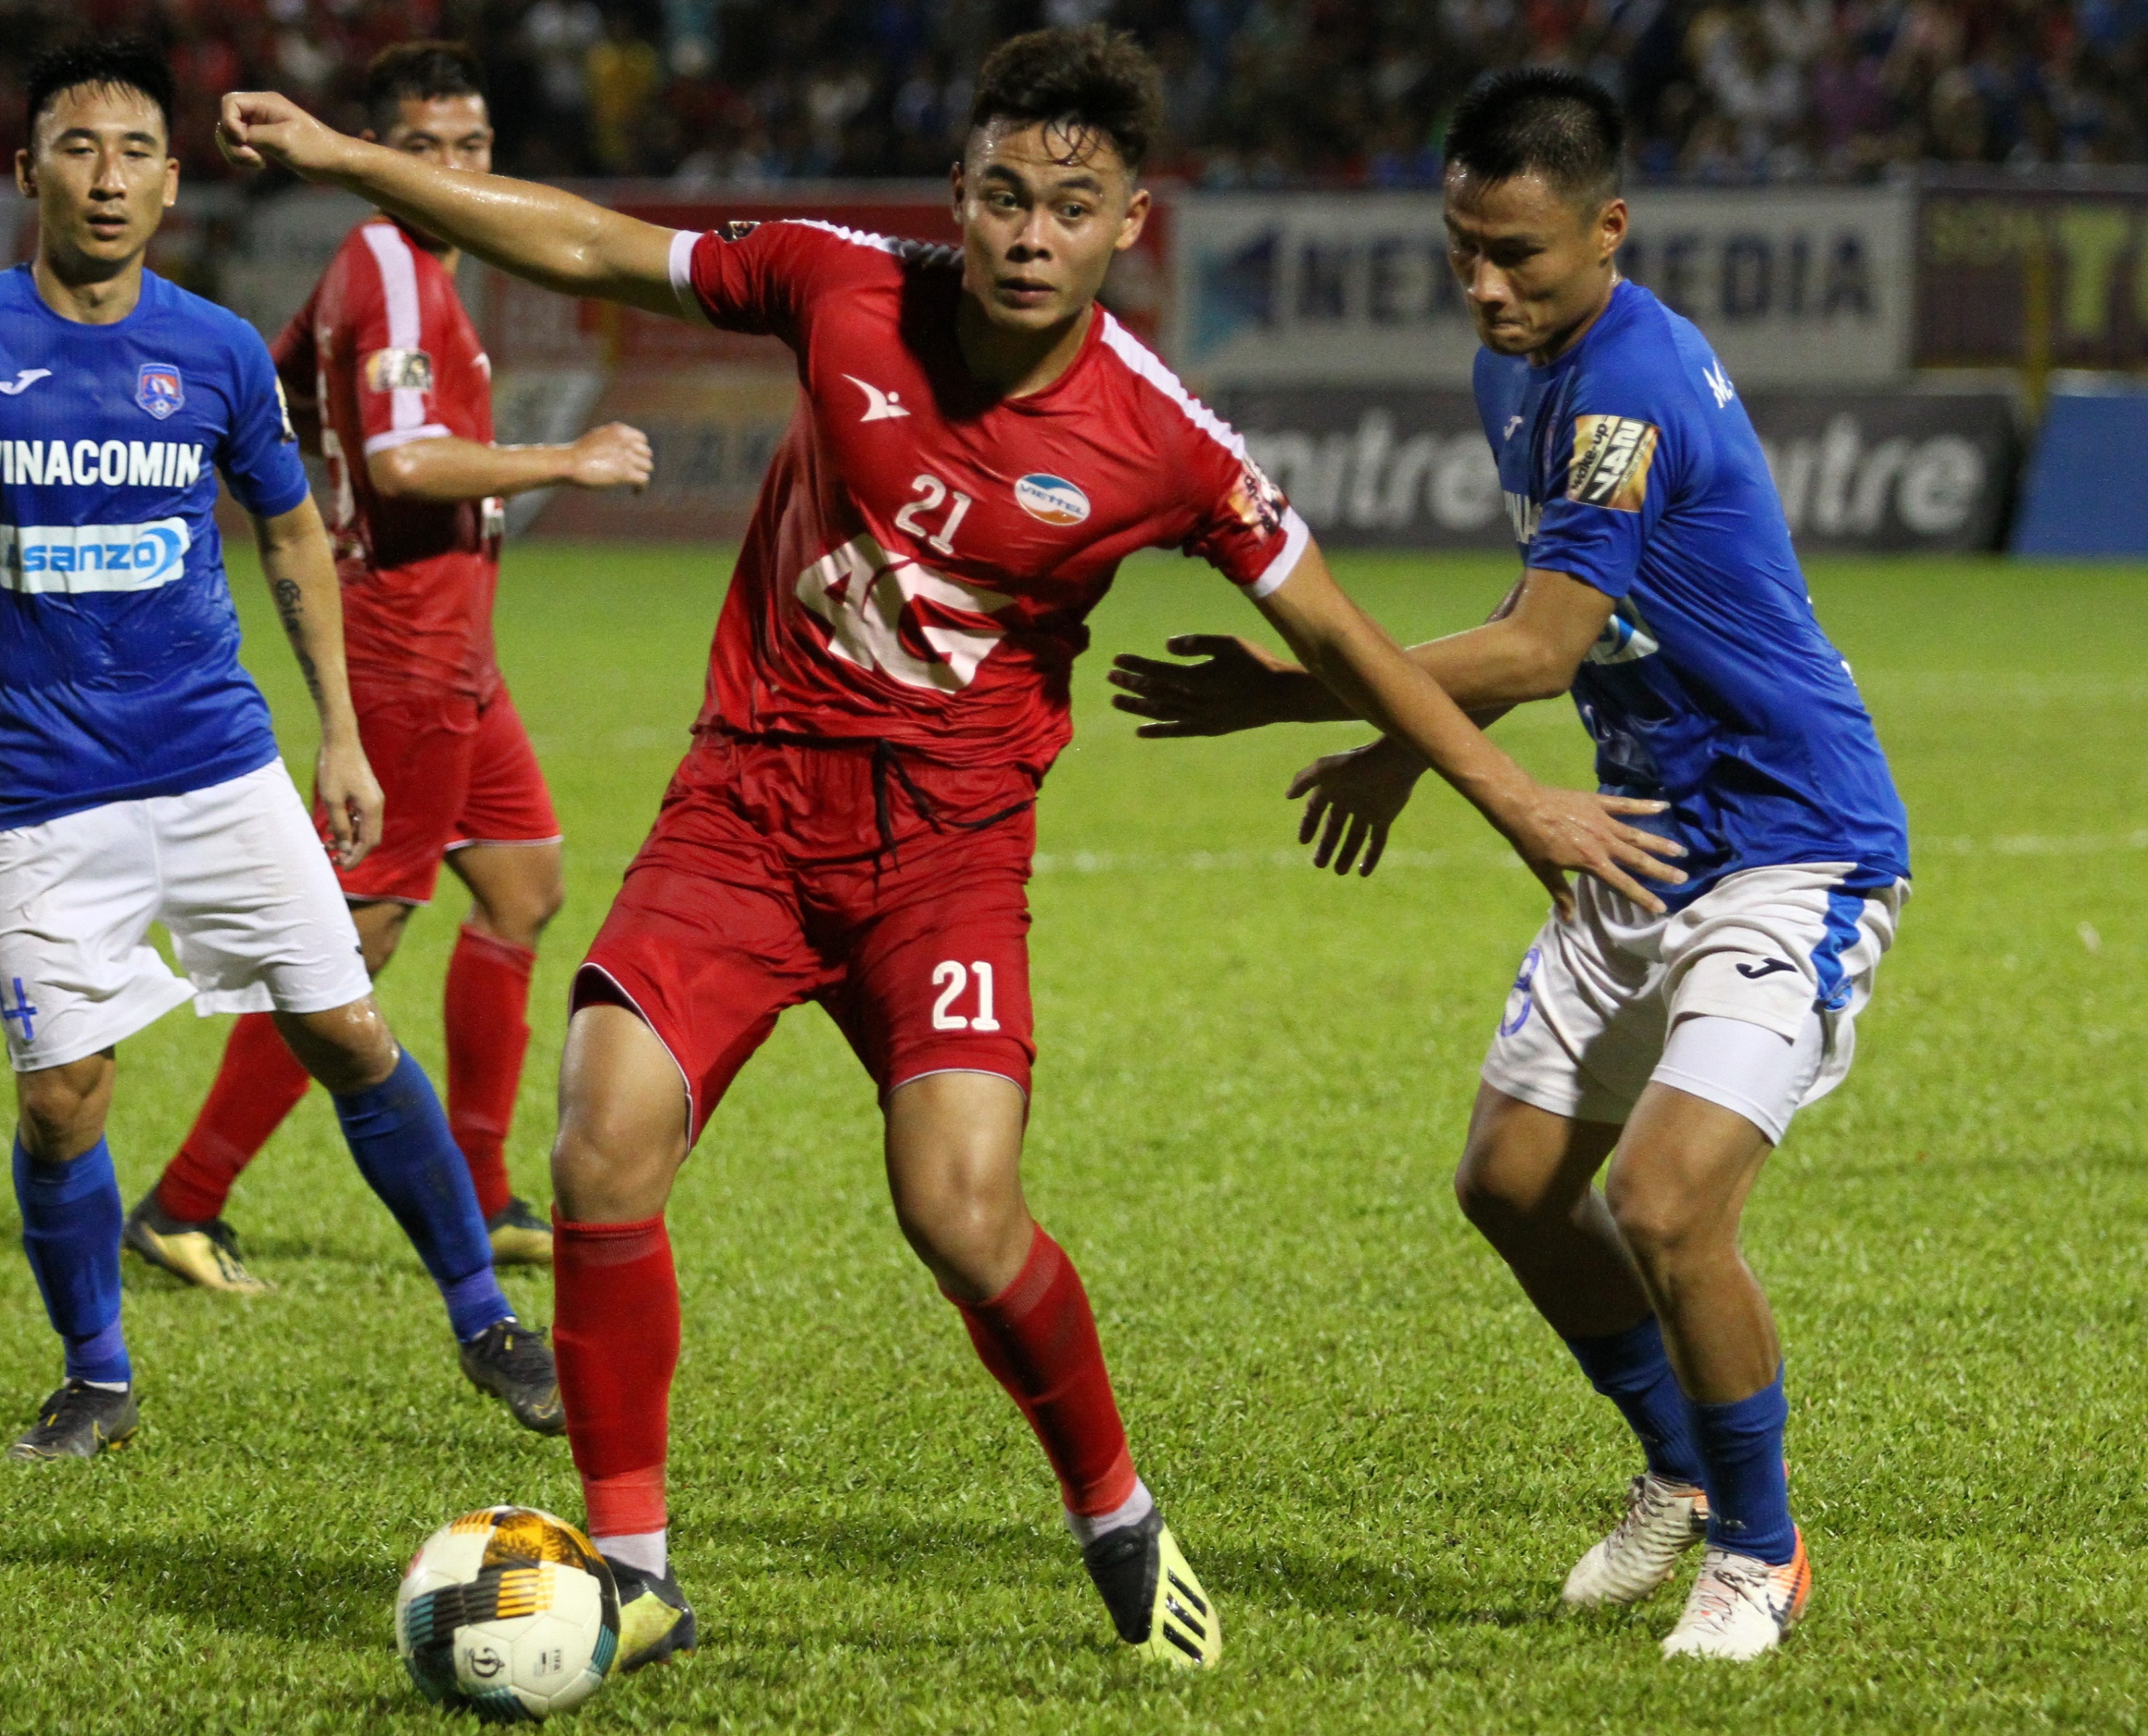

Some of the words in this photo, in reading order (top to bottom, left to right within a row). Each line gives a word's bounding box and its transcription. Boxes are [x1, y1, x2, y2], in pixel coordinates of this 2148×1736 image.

[0, 440, 202, 487] INACOMIN
[1759, 408, 1988, 534] itre
[895, 473, 972, 555] 21
[795, 532, 1019, 694] 4G
[932, 960, 1001, 1031] 21
